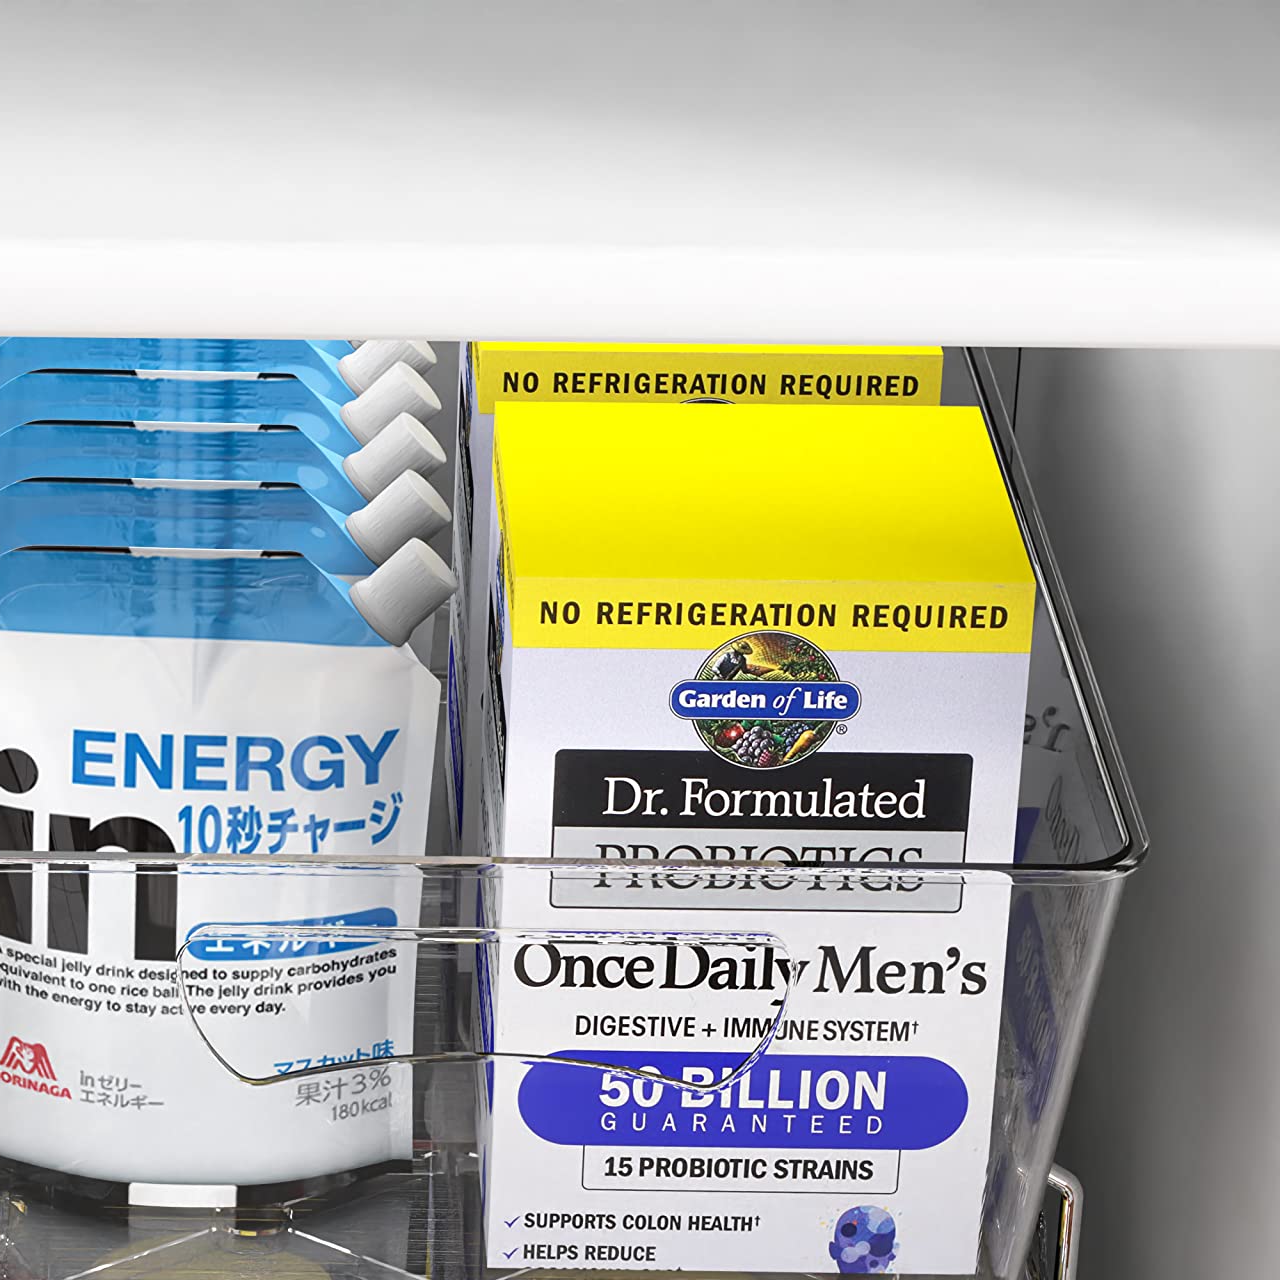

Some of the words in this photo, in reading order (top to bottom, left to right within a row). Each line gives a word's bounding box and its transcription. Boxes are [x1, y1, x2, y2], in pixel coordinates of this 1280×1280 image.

[503, 371, 539, 393] NO
[553, 371, 766, 395] REFRIGERATION
[780, 373, 919, 400] REQUIRED
[540, 601, 581, 625] NO
[596, 601, 837, 628] REFRIGERATION
[851, 603, 1008, 632] REQUIRED
[678, 688, 766, 710] Garden
[772, 687, 802, 715] of
[804, 690, 848, 711] Life
[71, 728, 400, 793] ENERGY
[602, 775, 668, 817] Dr.
[680, 778, 927, 819] Formulated
[178, 791, 404, 856] 10秒チャージ
[594, 843, 924, 892] PROBIOTICS
[6, 947, 57, 969] special
[61, 958, 91, 977] jelly
[95, 963, 134, 979] drink
[213, 969, 227, 980] to
[232, 967, 283, 983] supply
[288, 948, 398, 978] carbohydrates
[70, 978, 84, 991] to
[89, 981, 116, 995] one
[120, 984, 148, 998] rice
[188, 985, 214, 997] The
[218, 985, 250, 1000] jelly
[254, 983, 293, 997] drink
[297, 972, 364, 995] provides
[368, 965, 397, 983] you
[25, 985, 48, 1000] the
[52, 992, 103, 1012] energy
[106, 1000, 121, 1012] to
[125, 1003, 157, 1017] stay
[161, 1004, 206, 1017] actve
[210, 1003, 251, 1017] every
[255, 1002, 285, 1016] day.
[575, 1015, 695, 1038] DIGESTIVE
[701, 1023, 717, 1037] +
[723, 1017, 817, 1040] IMMUNE
[79, 1089, 165, 1110] エネルギー
[599, 1066, 663, 1108] 50
[680, 1066, 887, 1111] BILLION
[600, 1113, 883, 1135] GUARANTEED
[604, 1157, 633, 1177] 15
[638, 1157, 767, 1179] PROBIOTIC
[773, 1159, 874, 1181] STRAINS
[523, 1213, 616, 1229] SUPPORTS
[622, 1214, 682, 1230] COLON
[523, 1244, 579, 1260] HELPS
[585, 1245, 656, 1262] REDUCE
